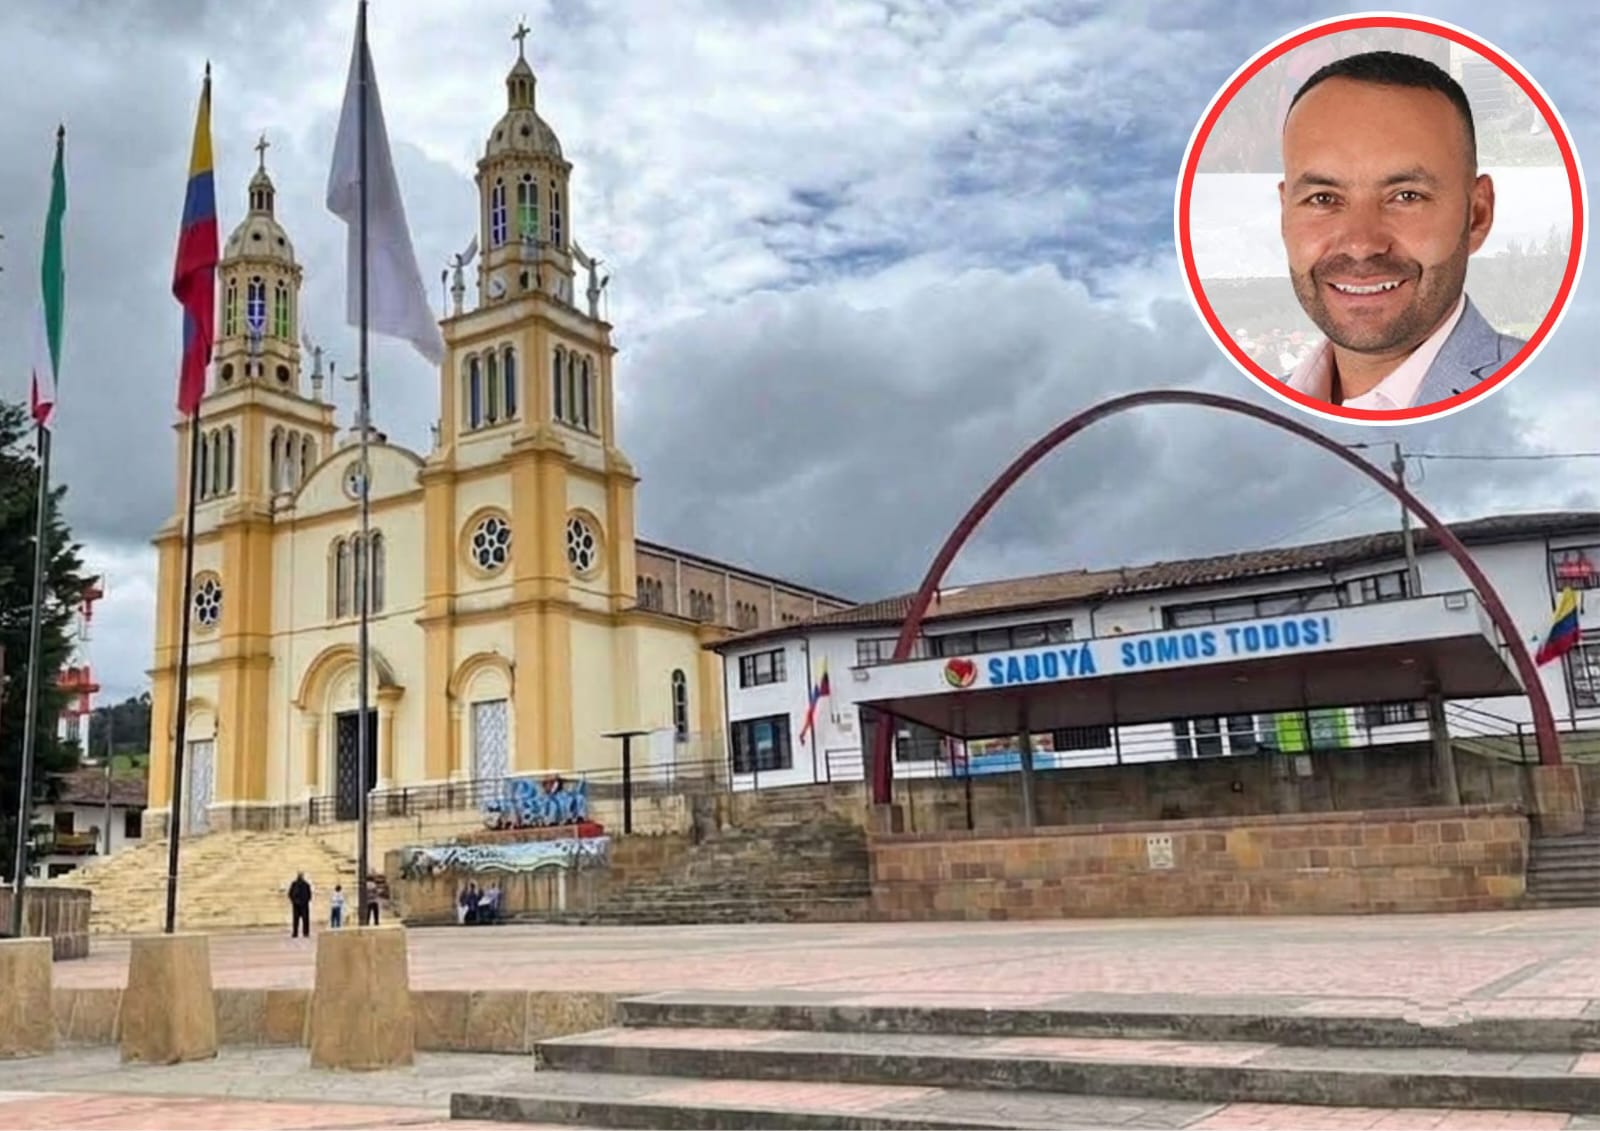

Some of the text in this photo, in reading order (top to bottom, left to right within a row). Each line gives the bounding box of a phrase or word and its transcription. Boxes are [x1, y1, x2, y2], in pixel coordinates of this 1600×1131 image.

[988, 617, 1333, 685] SABOYÁ SOMOS TODOS!
